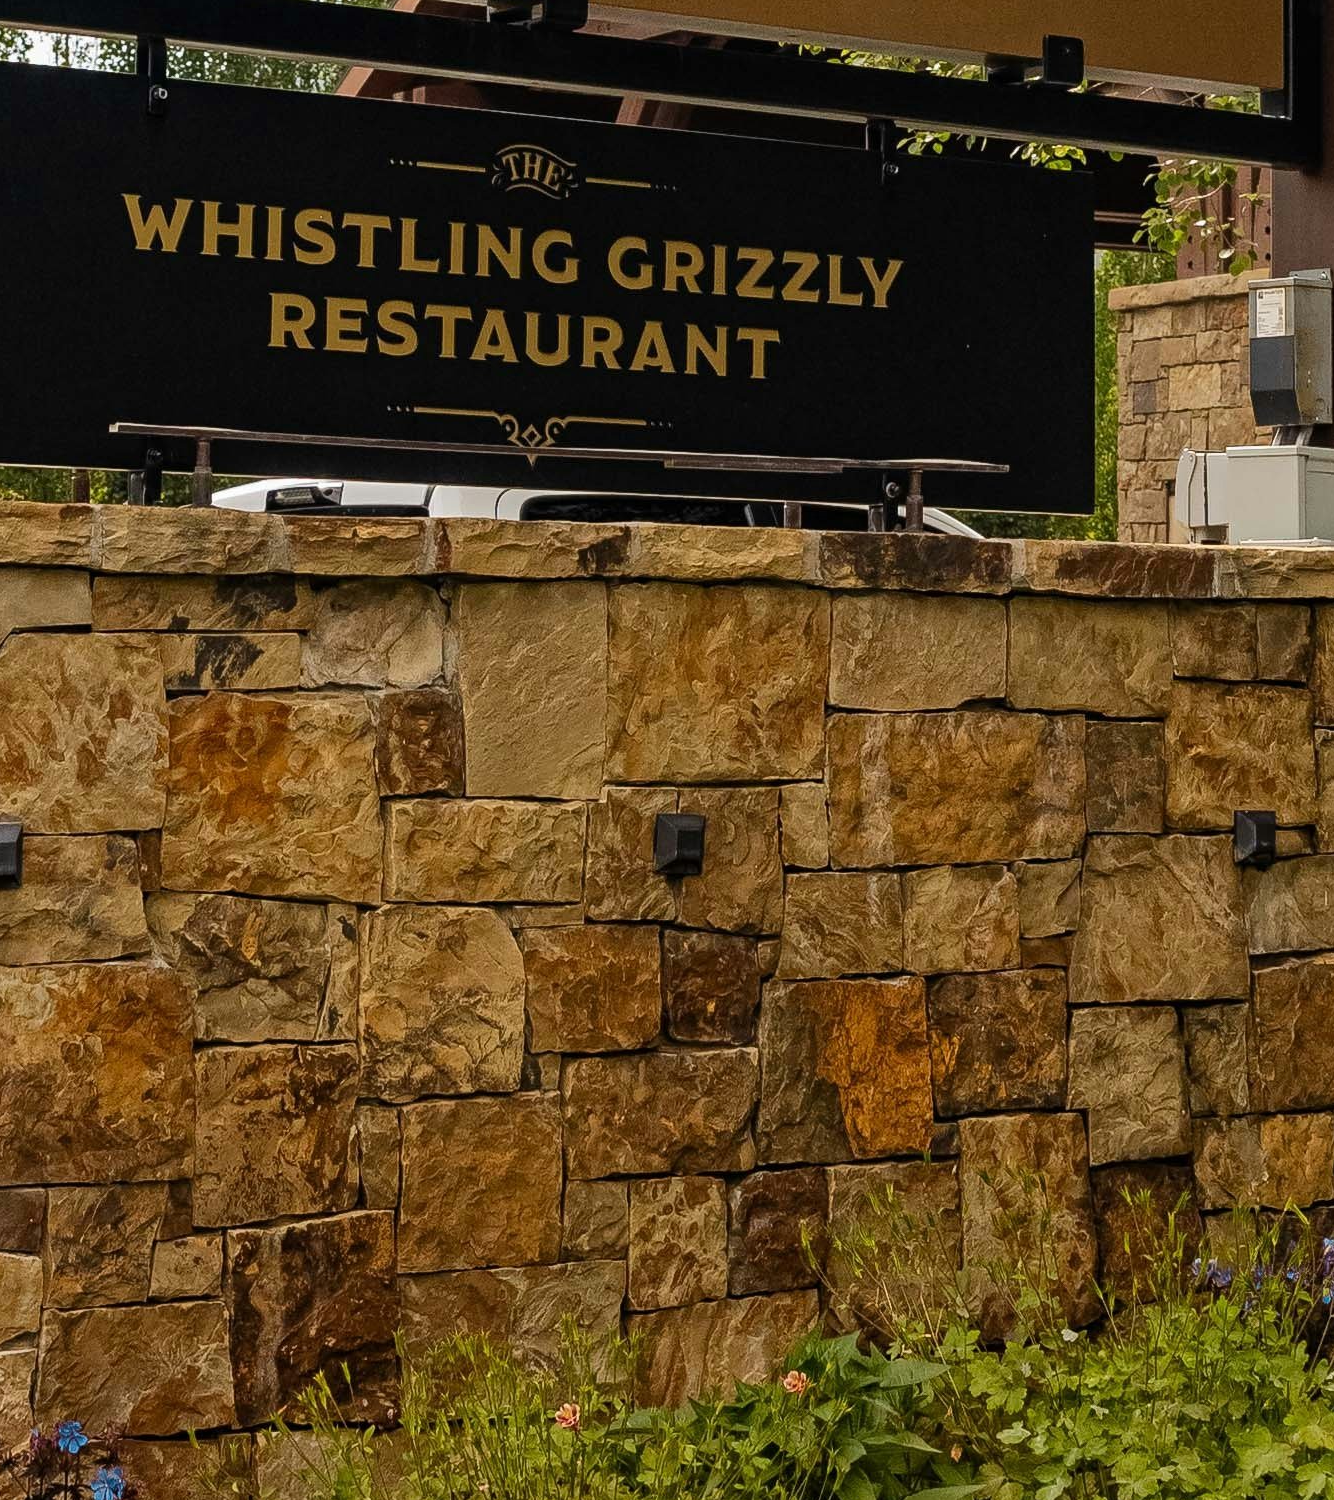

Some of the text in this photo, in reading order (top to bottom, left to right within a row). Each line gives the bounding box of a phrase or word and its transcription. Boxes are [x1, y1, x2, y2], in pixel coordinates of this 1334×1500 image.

[501, 151, 566, 192] THE
[121, 193, 904, 309] WHISTLING GRIZZLY
[267, 292, 781, 380] RESTAURANT
